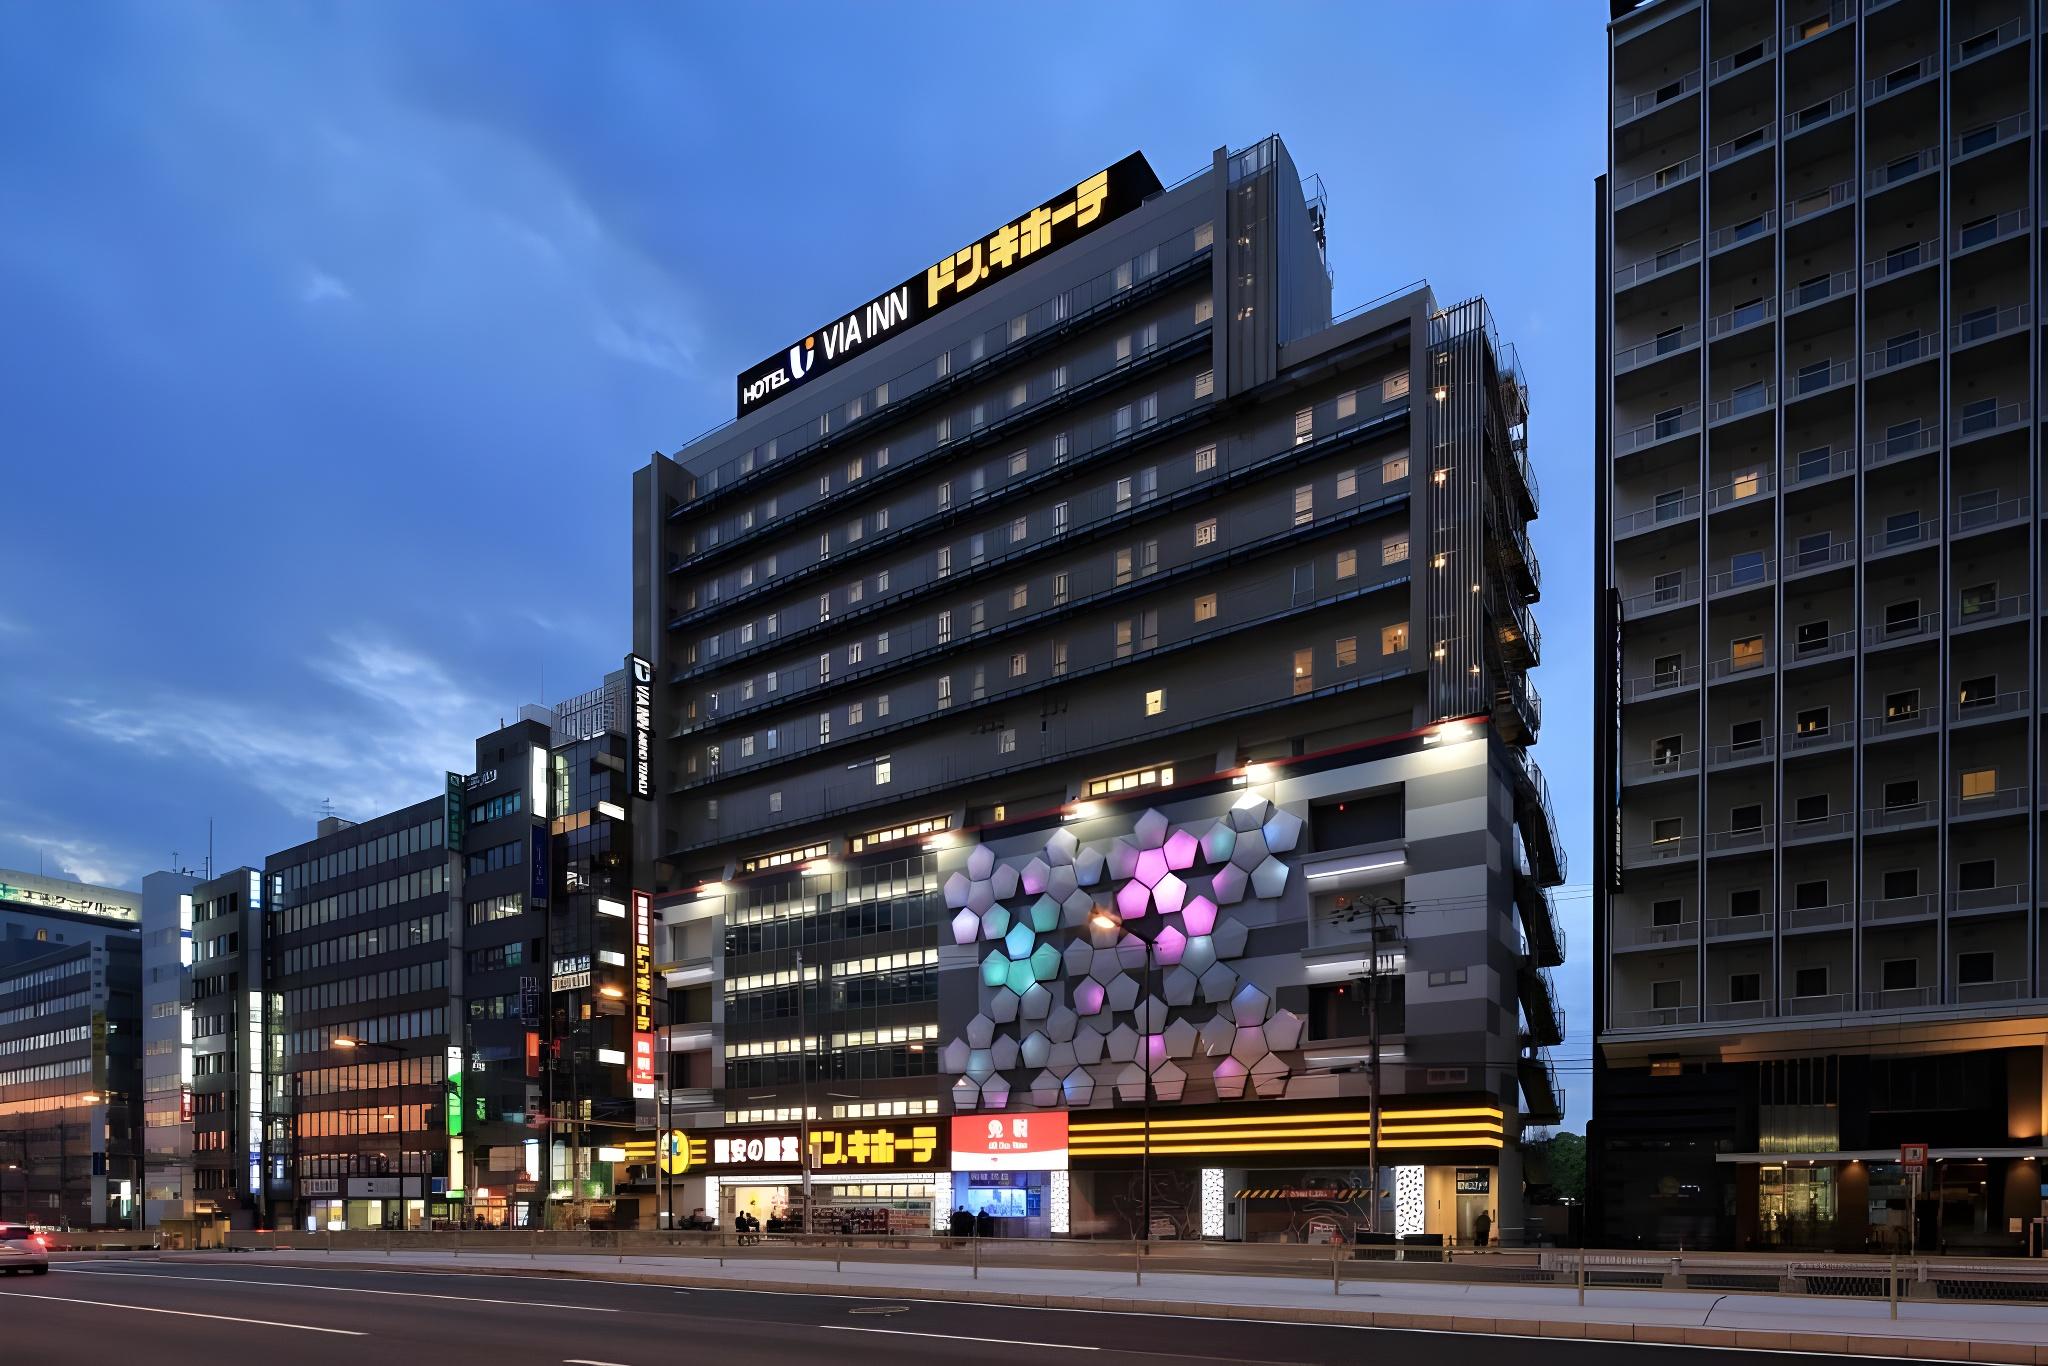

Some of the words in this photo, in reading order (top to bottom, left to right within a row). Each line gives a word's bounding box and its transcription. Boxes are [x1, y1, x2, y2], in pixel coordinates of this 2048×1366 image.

[743, 368, 790, 405] HOTEL
[822, 314, 863, 360] VIA
[866, 286, 908, 339] INN
